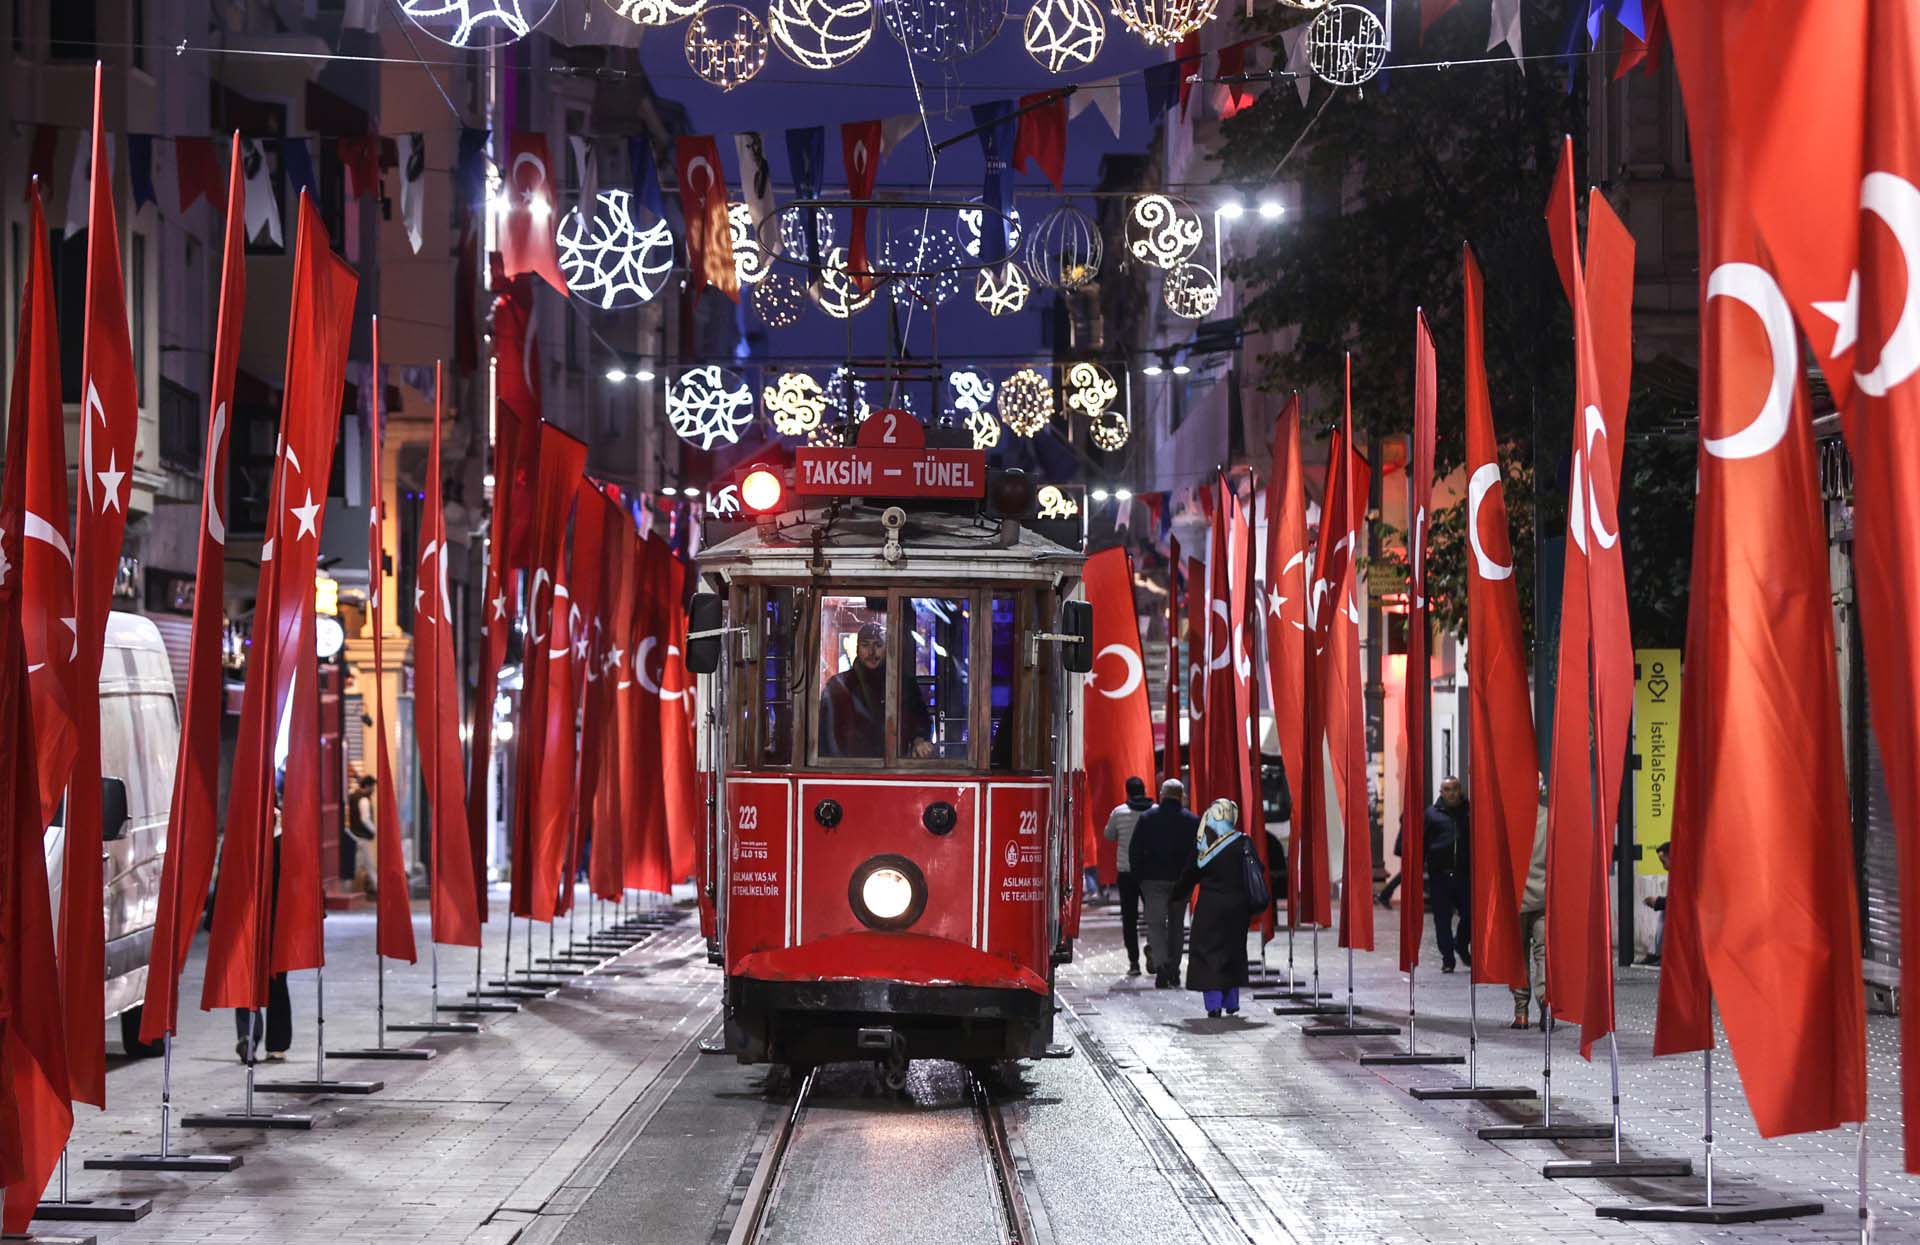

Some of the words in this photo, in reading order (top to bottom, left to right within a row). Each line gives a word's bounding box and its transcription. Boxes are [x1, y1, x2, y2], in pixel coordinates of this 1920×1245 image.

[882, 414, 897, 444] 2
[803, 455, 873, 485] TAKSİM
[913, 456, 974, 487] TÜNEL
[739, 805, 758, 830] 223
[1019, 810, 1038, 835] 223
[741, 849, 753, 859] ALO
[754, 850, 768, 860] 153
[1020, 854, 1034, 863] ALO
[754, 871, 777, 882] YASAK
[1002, 877, 1031, 888] ASILMAK
[1001, 890, 1011, 902] VE
